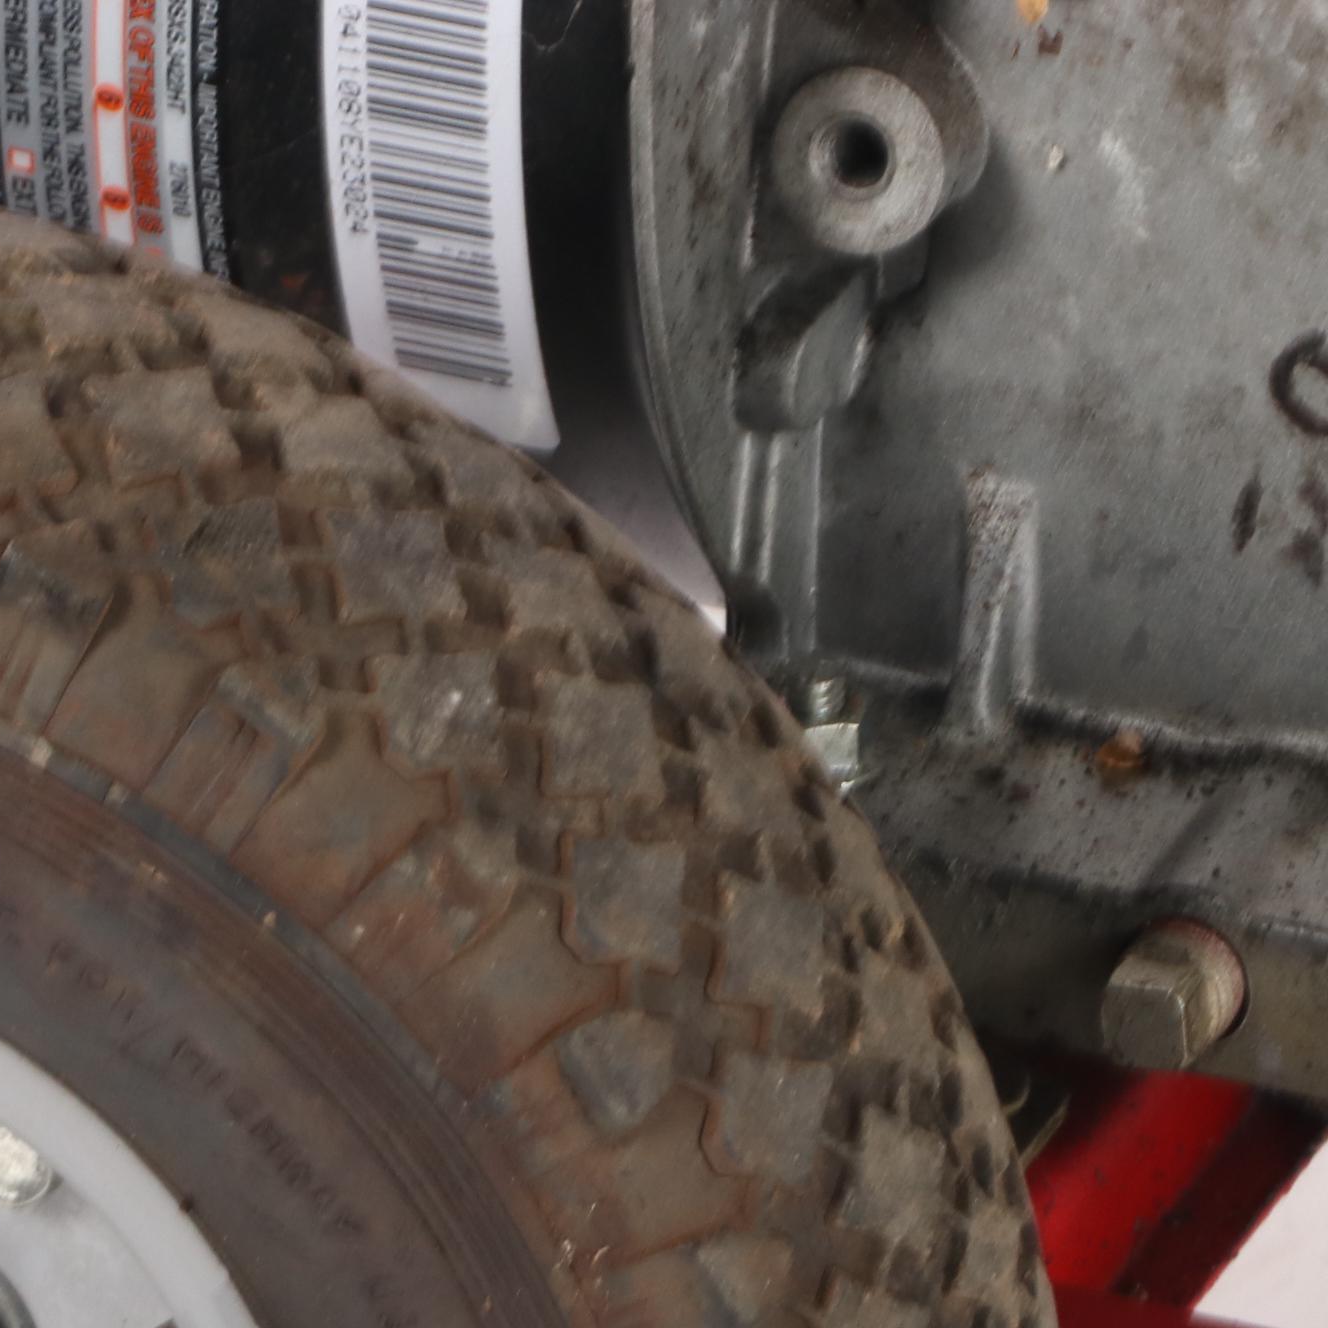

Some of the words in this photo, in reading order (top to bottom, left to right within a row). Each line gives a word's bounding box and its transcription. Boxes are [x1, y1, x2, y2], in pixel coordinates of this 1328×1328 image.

[129, 27, 154, 60] OF
[39, 93, 60, 129] FOR
[130, 63, 156, 120] THIS
[41, 131, 62, 163] THE
[198, 82, 221, 187] IMPORTANT
[131, 123, 160, 209] ENGINE
[138, 209, 164, 234] IS
[202, 188, 225, 250] ENGINE
